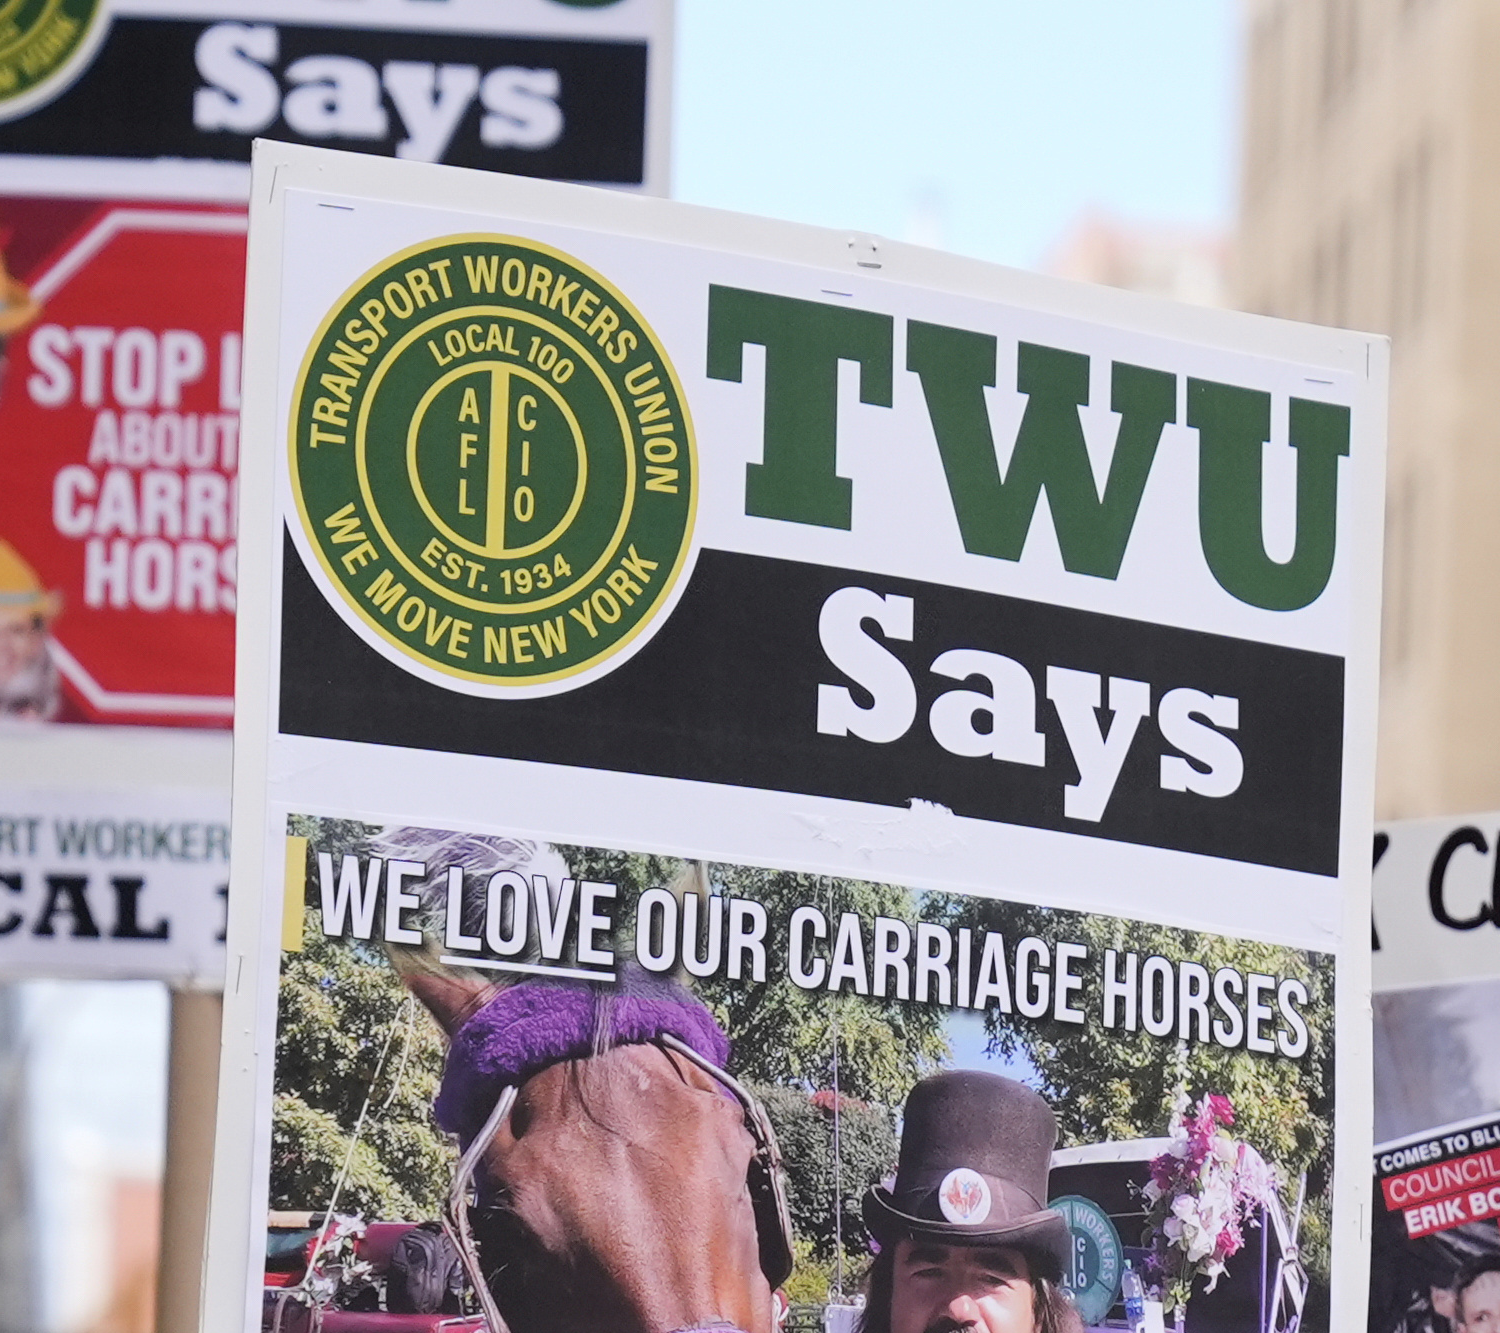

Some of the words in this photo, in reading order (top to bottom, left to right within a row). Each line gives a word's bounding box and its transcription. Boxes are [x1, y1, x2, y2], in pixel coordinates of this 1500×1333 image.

[192, 22, 563, 163] Says
[28, 325, 205, 409] STOP
[310, 259, 453, 449] TRANSPORT
[462, 255, 638, 365] WORKERS
[623, 361, 678, 494] UNION
[427, 323, 520, 367] LOCAL
[527, 336, 576, 386] 100
[706, 283, 1351, 612] TWU
[323, 502, 379, 575] WE
[364, 569, 473, 658] MOVE
[483, 615, 567, 664] NEW
[569, 543, 660, 638] YORK
[420, 537, 488, 592] EST.
[502, 553, 573, 595] 1934
[817, 585, 1244, 822] Says
[317, 850, 423, 947] WE
[444, 864, 617, 967] LOVE
[635, 887, 767, 984] OUR
[787, 905, 1091, 1027] CARRIAGE
[1100, 948, 1308, 1060] HORSES
[1381, 1141, 1442, 1171] COMES
[1442, 1133, 1469, 1154] TO
[1405, 1199, 1466, 1234] ERIK
